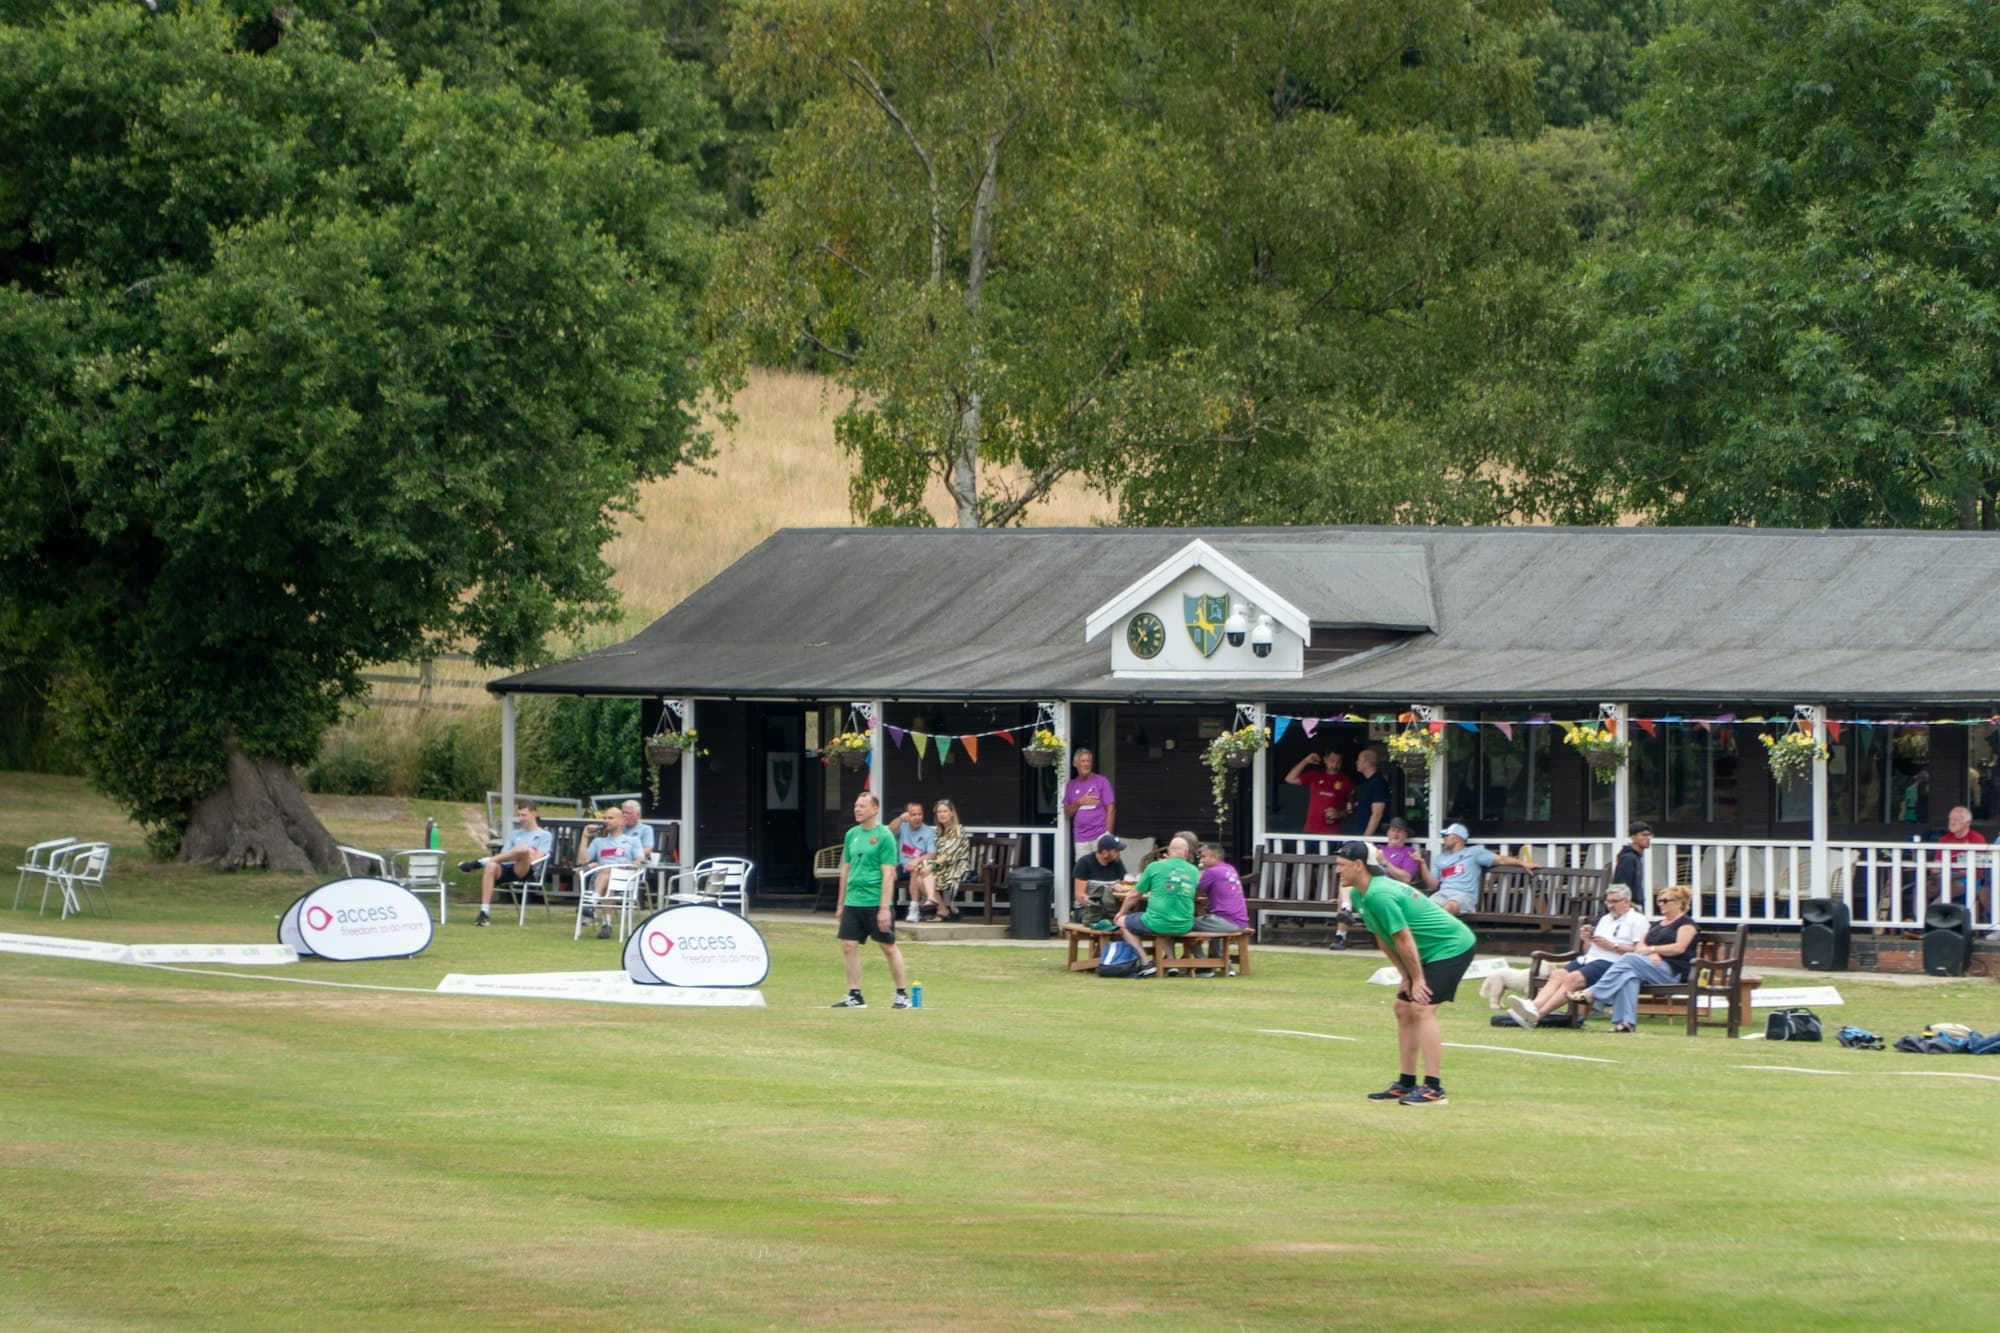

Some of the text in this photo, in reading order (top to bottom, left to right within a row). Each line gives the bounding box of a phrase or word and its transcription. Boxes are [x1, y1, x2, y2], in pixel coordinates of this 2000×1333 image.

[336, 905, 398, 924] access
[340, 925, 377, 937] freedom
[401, 922, 424, 931] more
[678, 935, 737, 951] access
